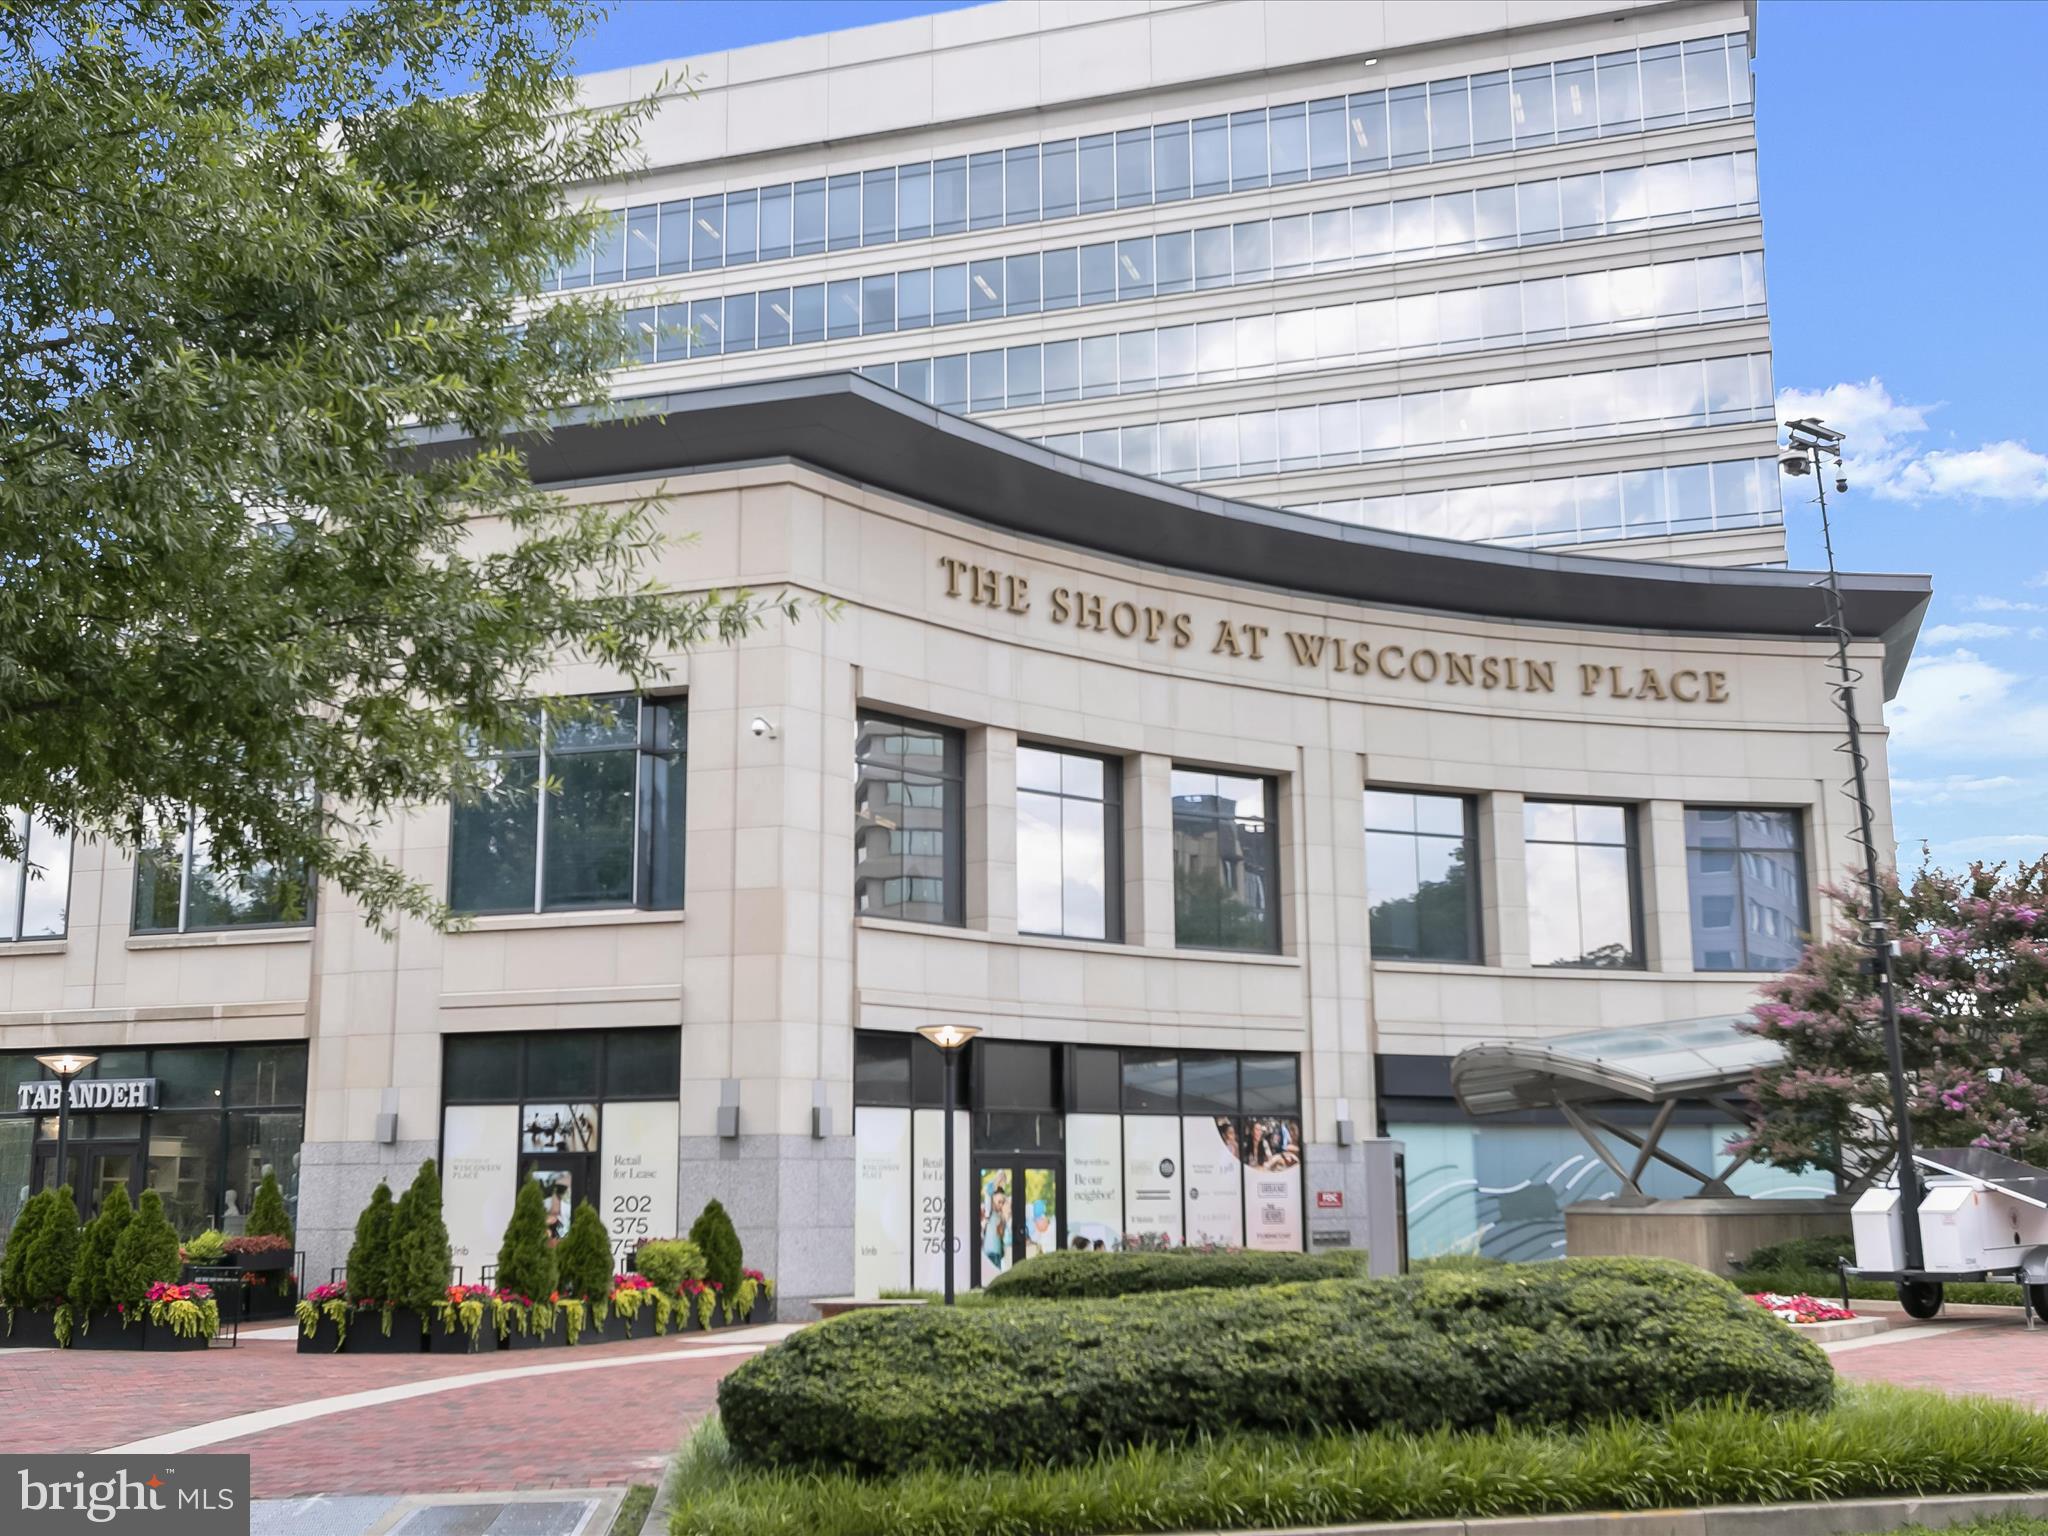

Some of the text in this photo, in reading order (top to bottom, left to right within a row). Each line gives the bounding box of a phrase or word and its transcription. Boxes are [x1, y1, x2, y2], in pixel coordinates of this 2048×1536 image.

[940, 556, 1730, 702] THE SHOPS AT WISCONSIN PLACE
[18, 1082, 146, 1110] TABANDEH
[614, 1154, 642, 1166] Retail
[613, 1168, 657, 1179] for Lease
[1074, 1173, 1103, 1185] Be our
[613, 1195, 651, 1212] 202
[922, 1196, 946, 1213] 20
[612, 1217, 648, 1234] 375
[610, 1239, 635, 1255] 75
